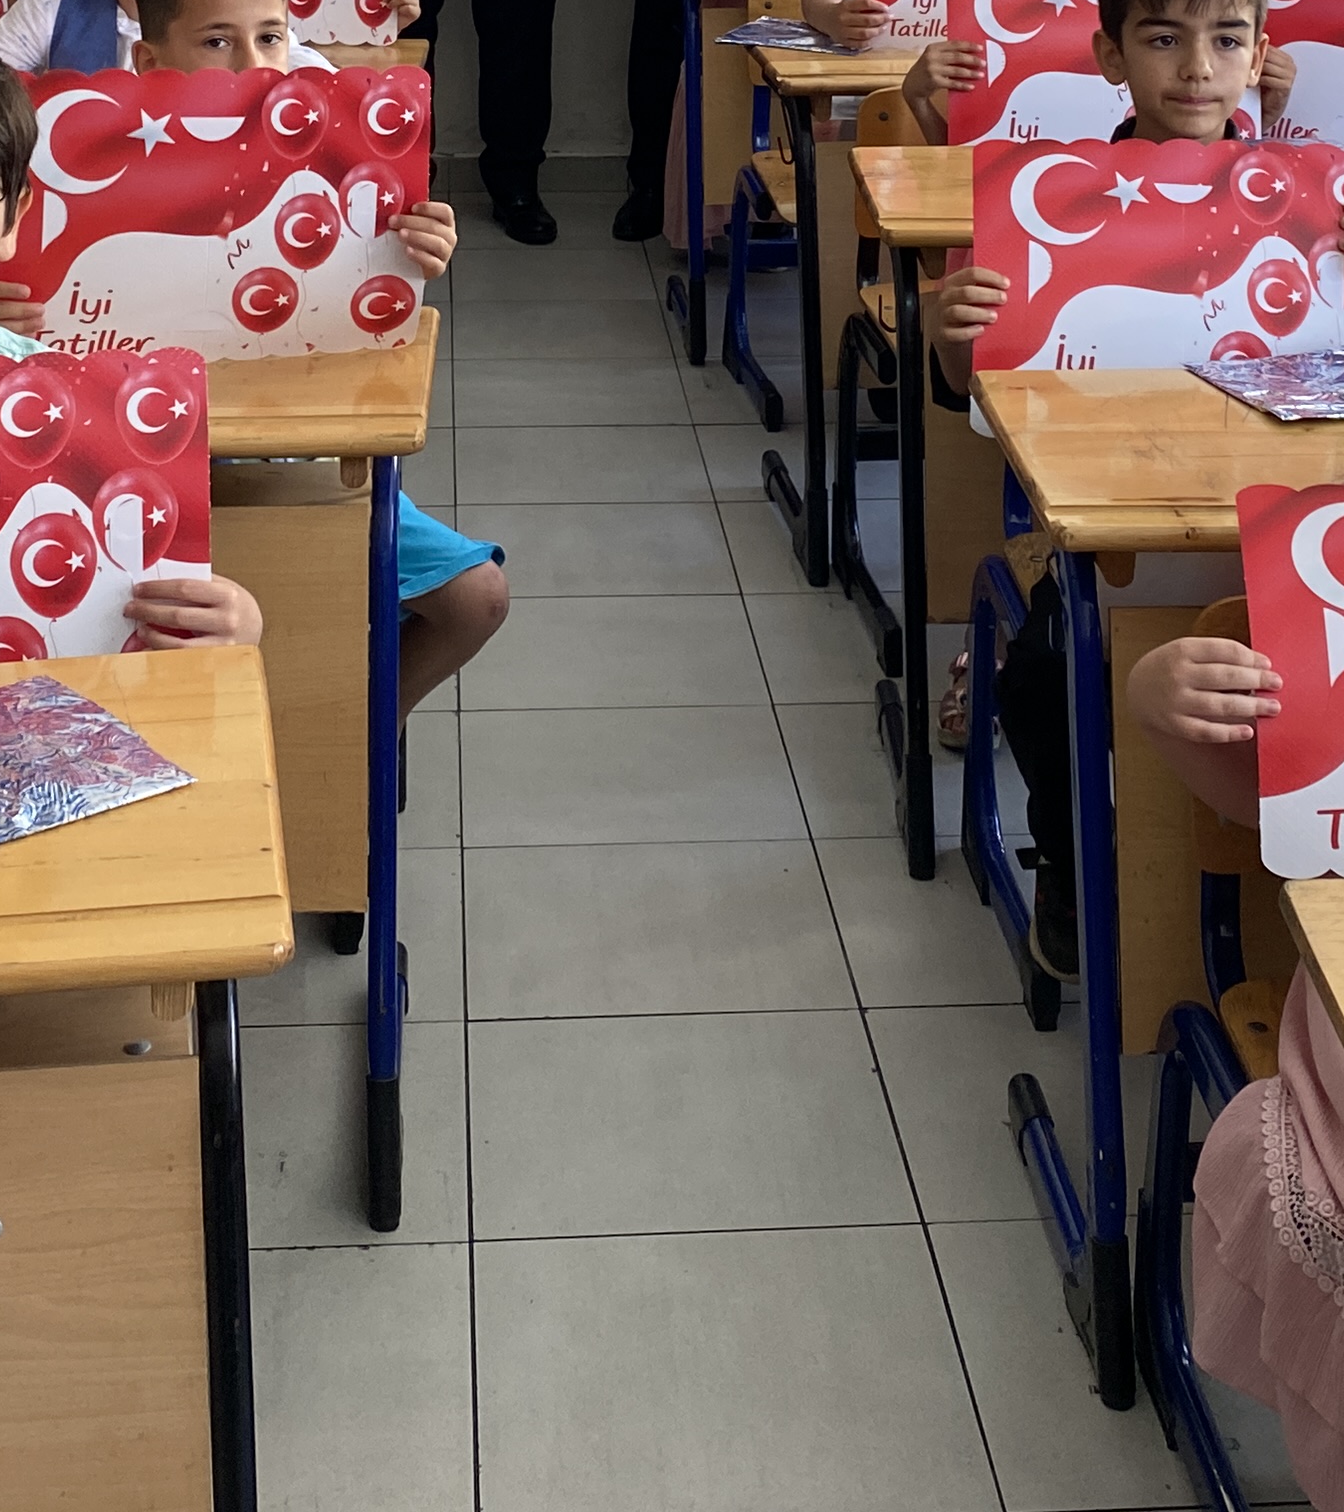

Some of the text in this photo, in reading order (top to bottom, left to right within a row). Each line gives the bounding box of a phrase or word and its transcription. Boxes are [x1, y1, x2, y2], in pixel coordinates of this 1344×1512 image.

[890, 18, 948, 37] Tatille
[1009, 110, 1040, 144] İyi
[1262, 117, 1320, 139] iller
[68, 281, 113, 324] İyi
